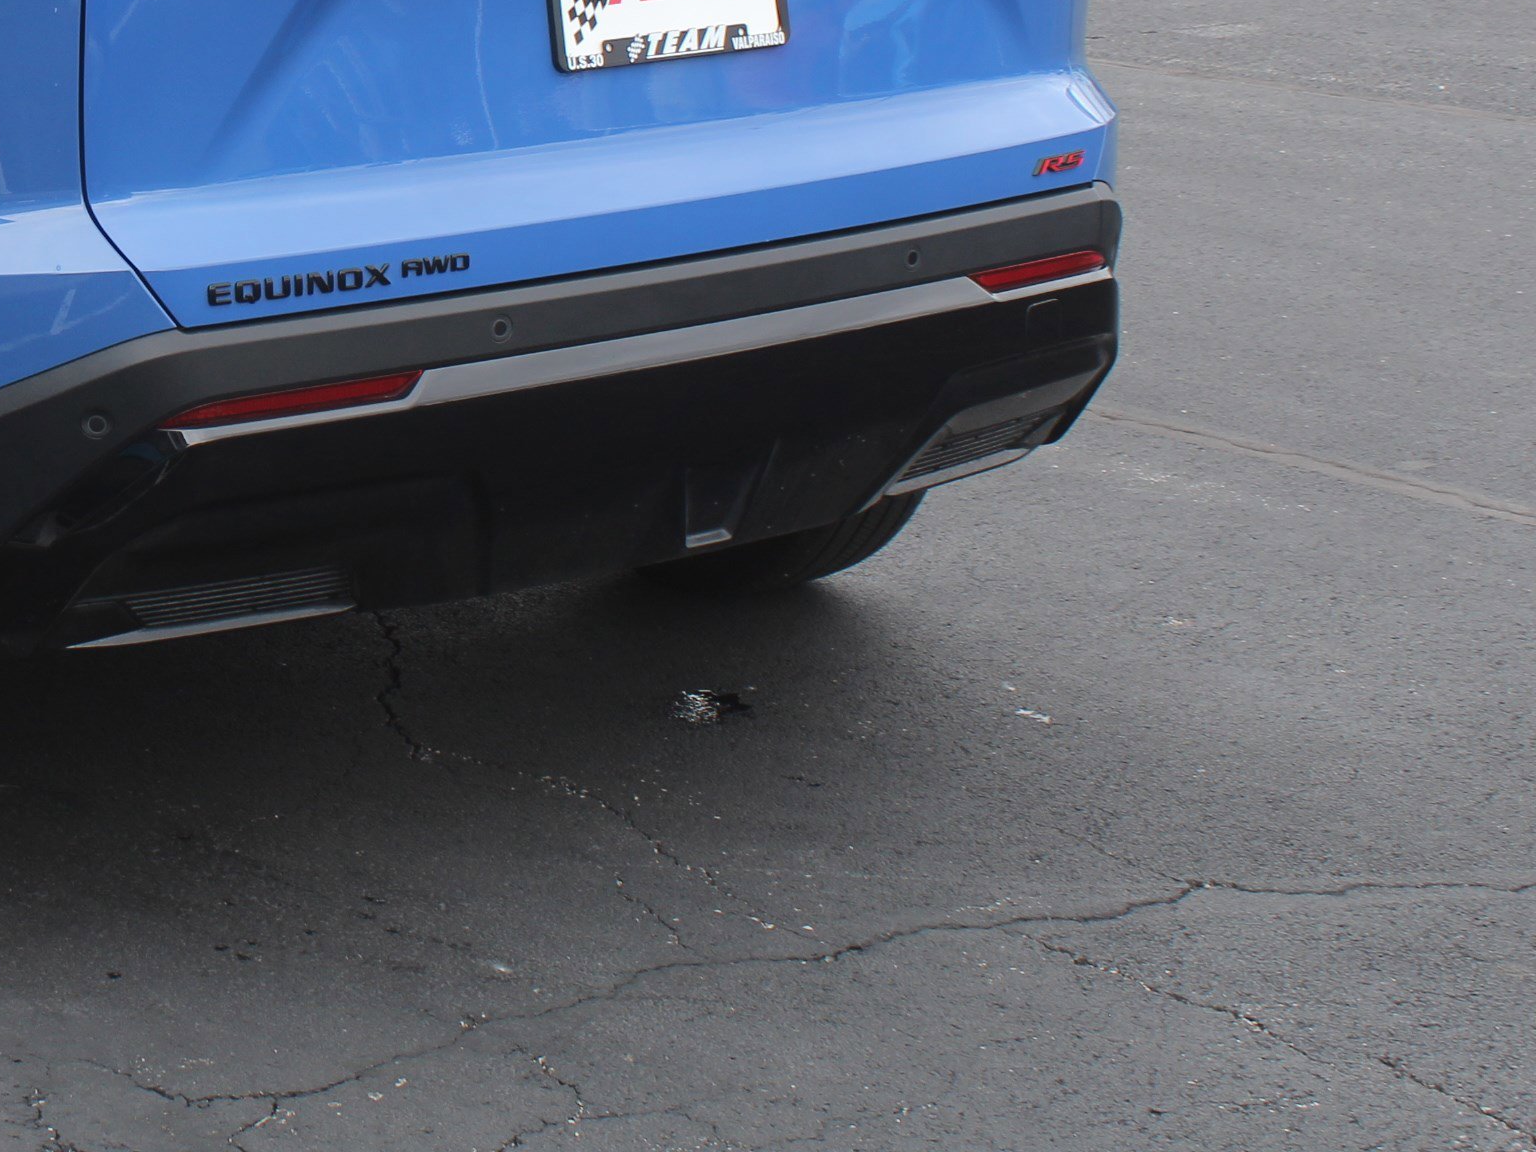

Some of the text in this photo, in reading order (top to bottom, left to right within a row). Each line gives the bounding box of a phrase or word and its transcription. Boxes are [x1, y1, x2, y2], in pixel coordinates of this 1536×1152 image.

[646, 24, 726, 57] TEAM
[731, 30, 786, 50] VALPARAISO
[1032, 150, 1086, 176] RS
[207, 253, 470, 307] EQUINOX AWD
